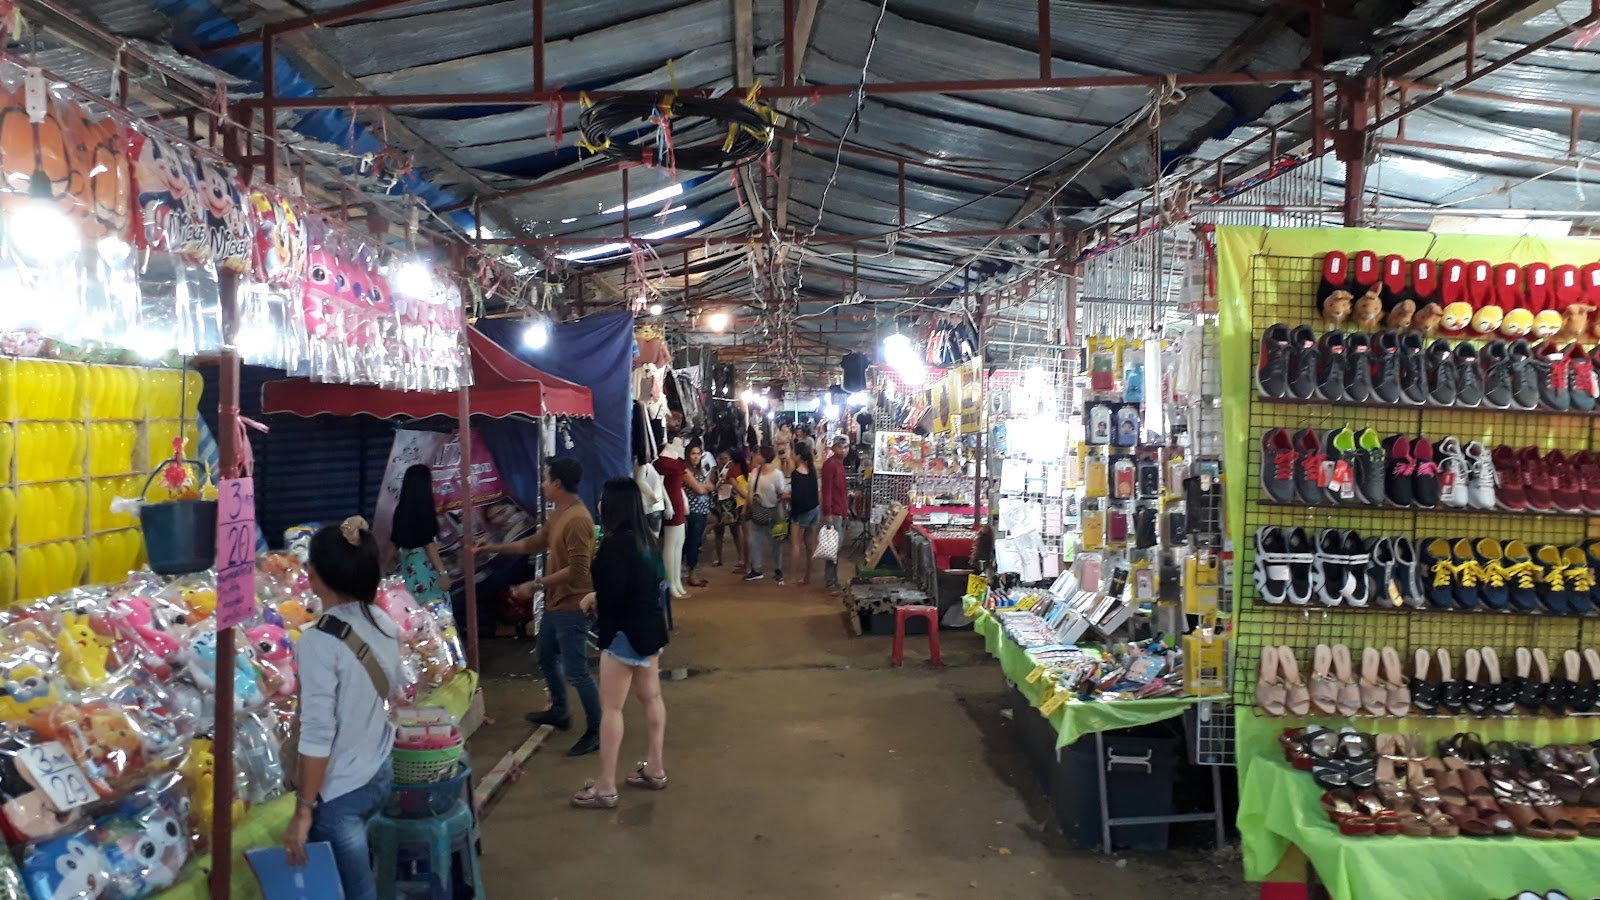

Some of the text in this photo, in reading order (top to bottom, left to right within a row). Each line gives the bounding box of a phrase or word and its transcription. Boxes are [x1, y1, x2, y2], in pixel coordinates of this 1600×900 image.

[229, 482, 242, 520] 3
[228, 525, 250, 566] 20
[31, 747, 53, 774] 3
